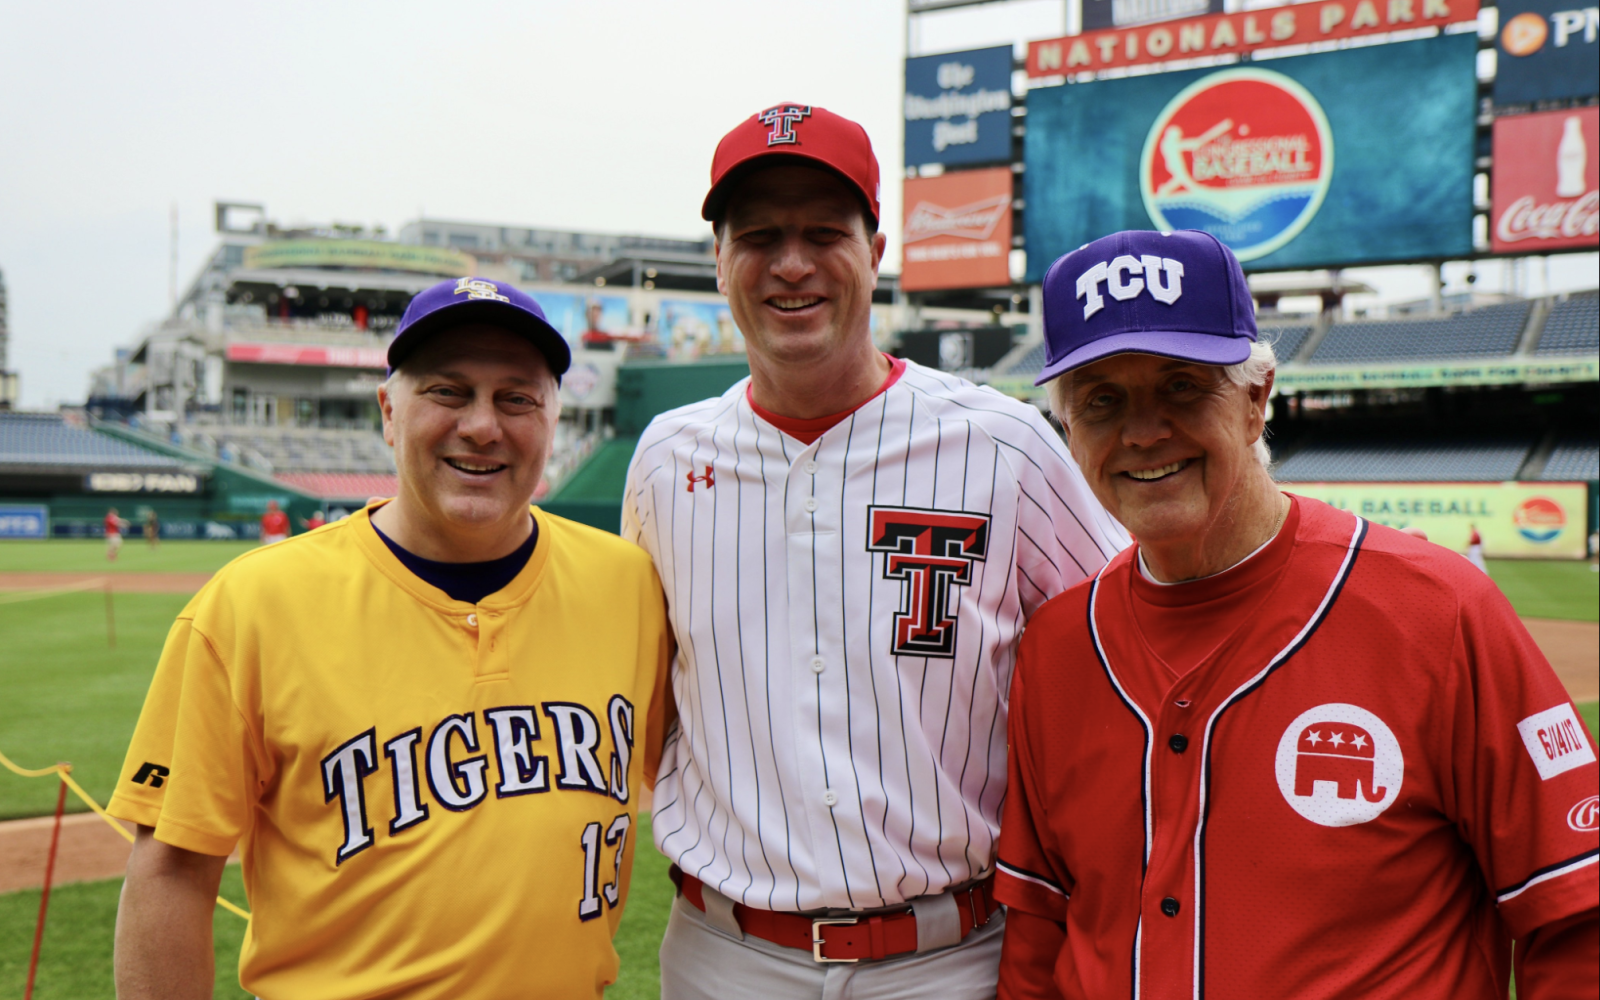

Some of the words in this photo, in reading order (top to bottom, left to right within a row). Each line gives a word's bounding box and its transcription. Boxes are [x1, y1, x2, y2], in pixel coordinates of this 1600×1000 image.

[1038, 9, 1297, 72] NATIONALS
[1319, 0, 1450, 34] PARK
[1192, 150, 1315, 181] BASEBALL
[1075, 254, 1185, 322] TCU
[1361, 499, 1494, 519] BASEBALL
[1536, 717, 1583, 761] 6/14/17
[320, 693, 635, 868] TIGERS
[578, 812, 631, 922] 13
